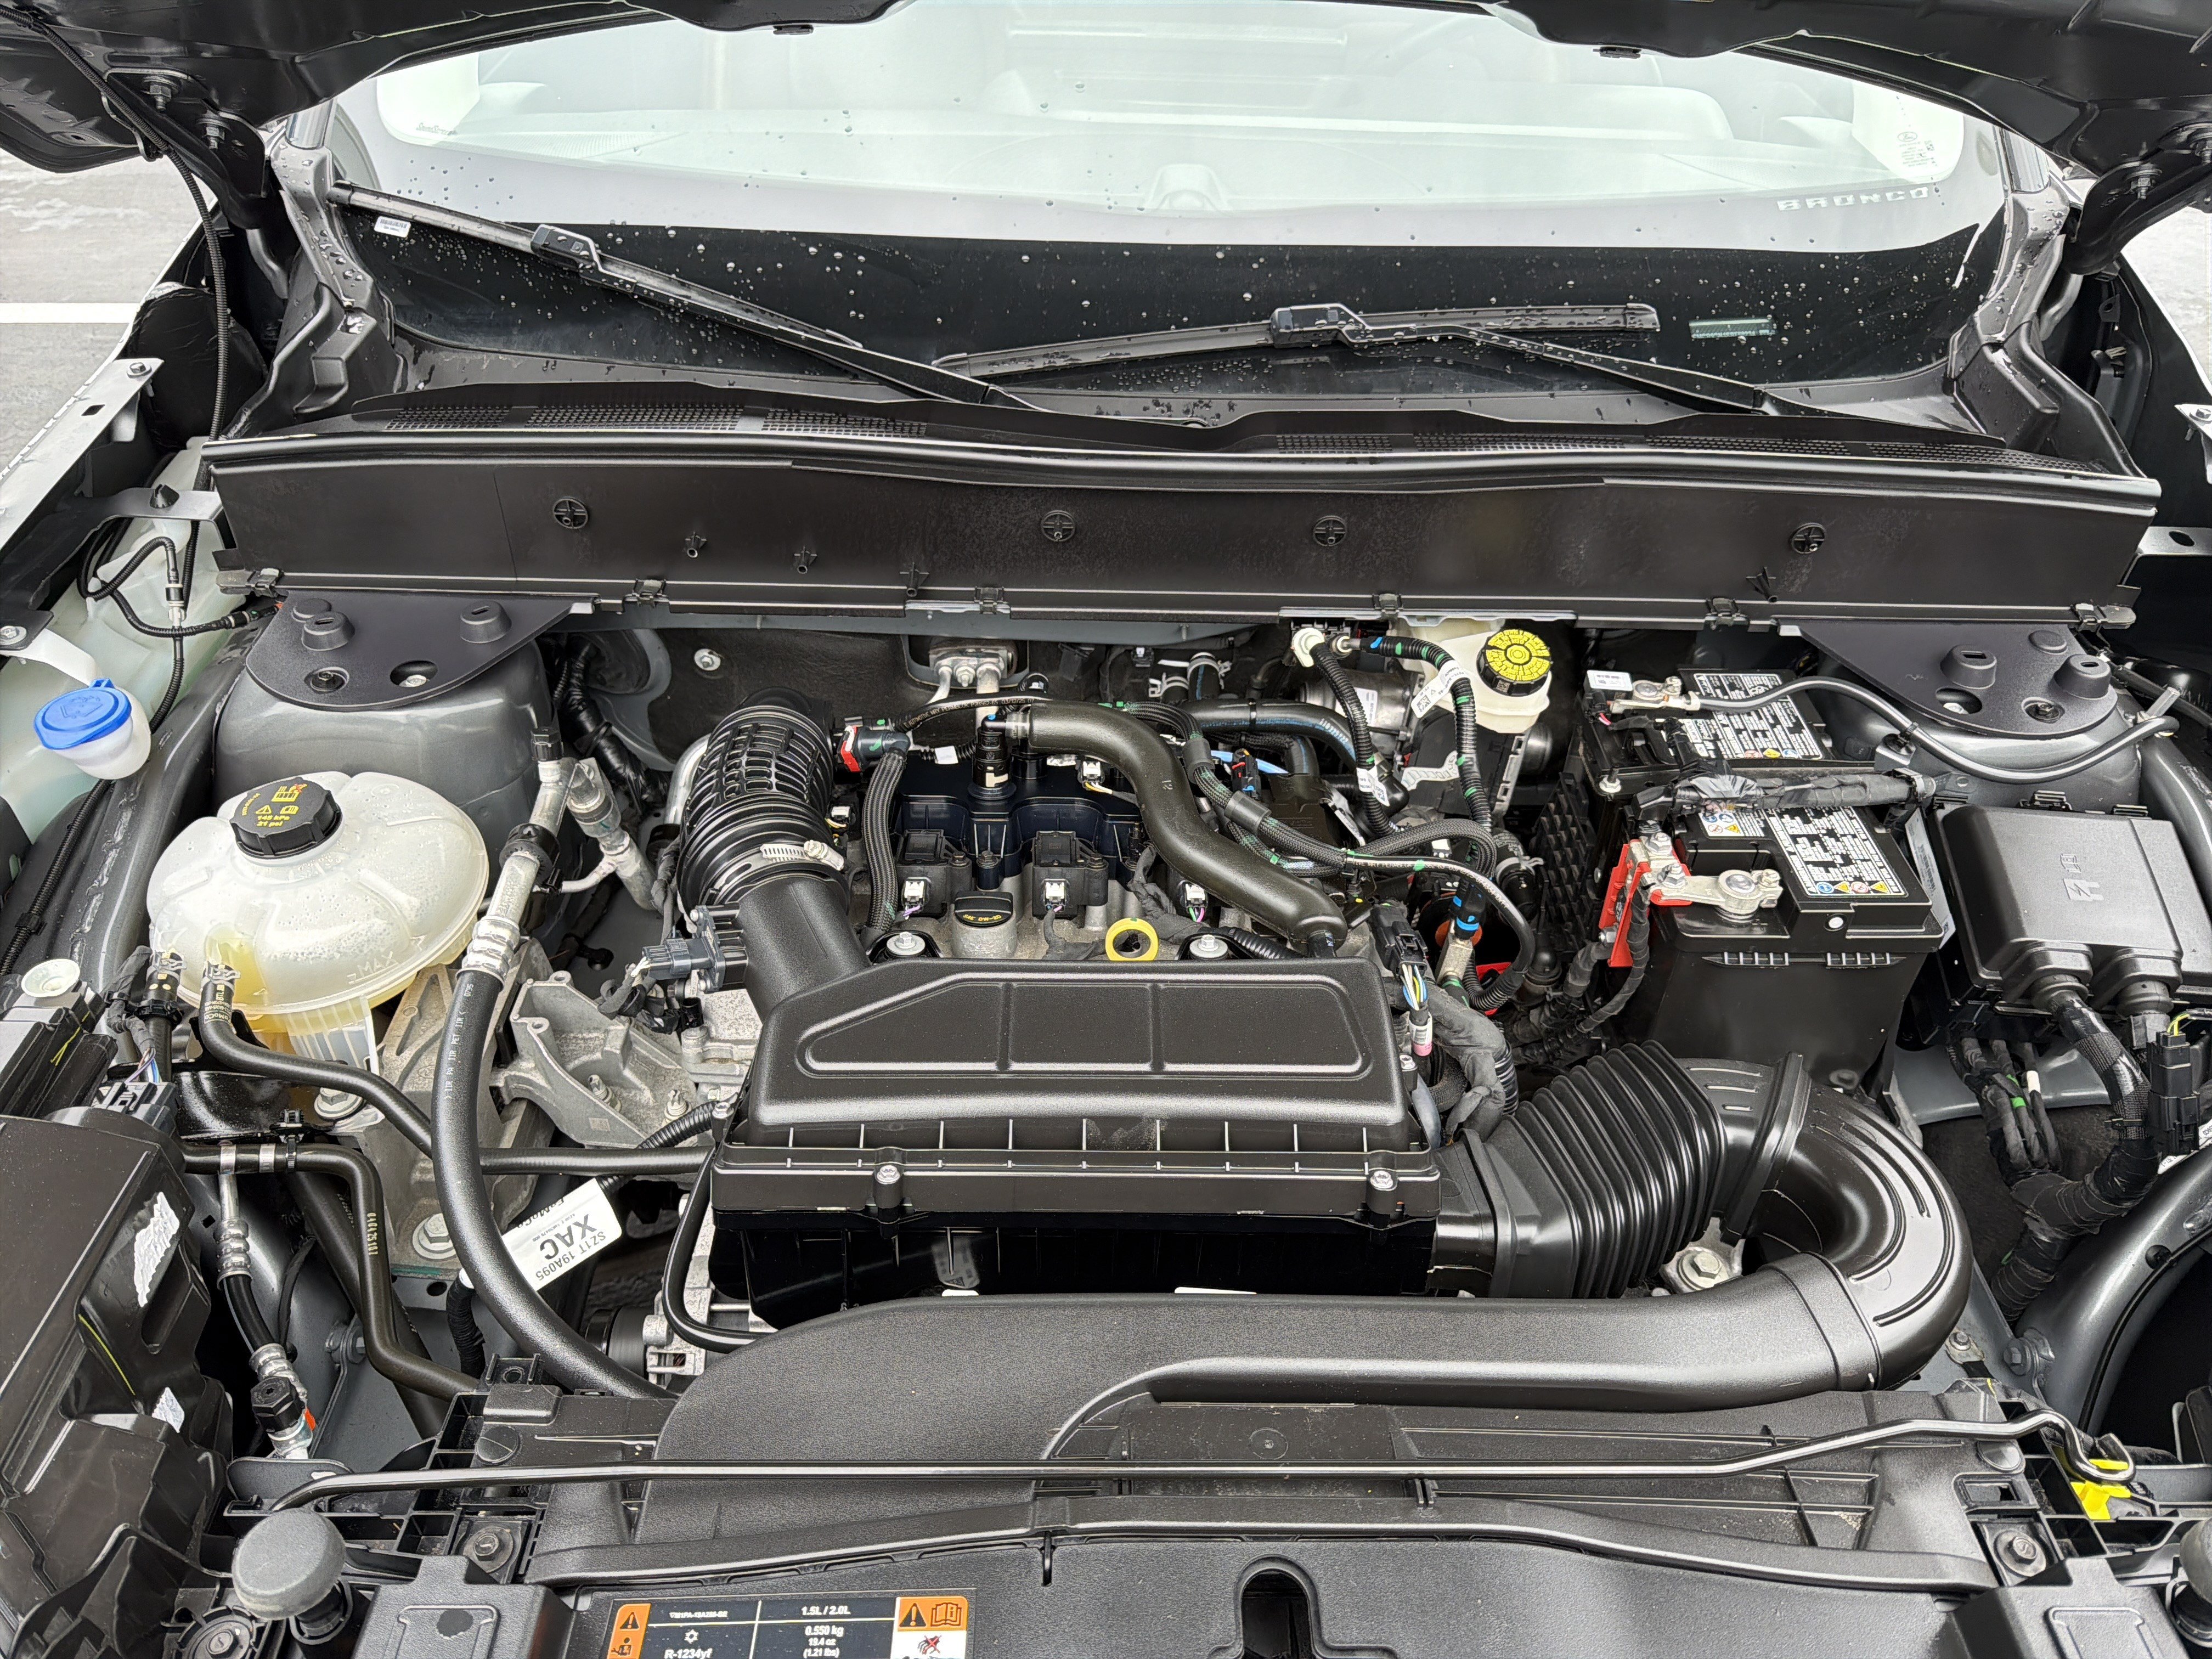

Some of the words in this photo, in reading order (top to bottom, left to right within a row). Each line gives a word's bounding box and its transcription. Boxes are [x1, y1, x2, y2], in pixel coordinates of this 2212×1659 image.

[1776, 187, 1928, 211] BRONCO
[357, 951, 398, 978] MAX
[451, 1034, 460, 1045] PET
[540, 1214, 597, 1260] XAC
[535, 1253, 576, 1281] 19A095
[802, 1606, 822, 1616] 1.5L
[829, 1605, 851, 1615] 2.0L
[805, 1625, 830, 1636] 0.550
[831, 1624, 844, 1637] kg
[664, 1647, 713, 1659] R-1234yf
[823, 1647, 840, 1658] lbs)
